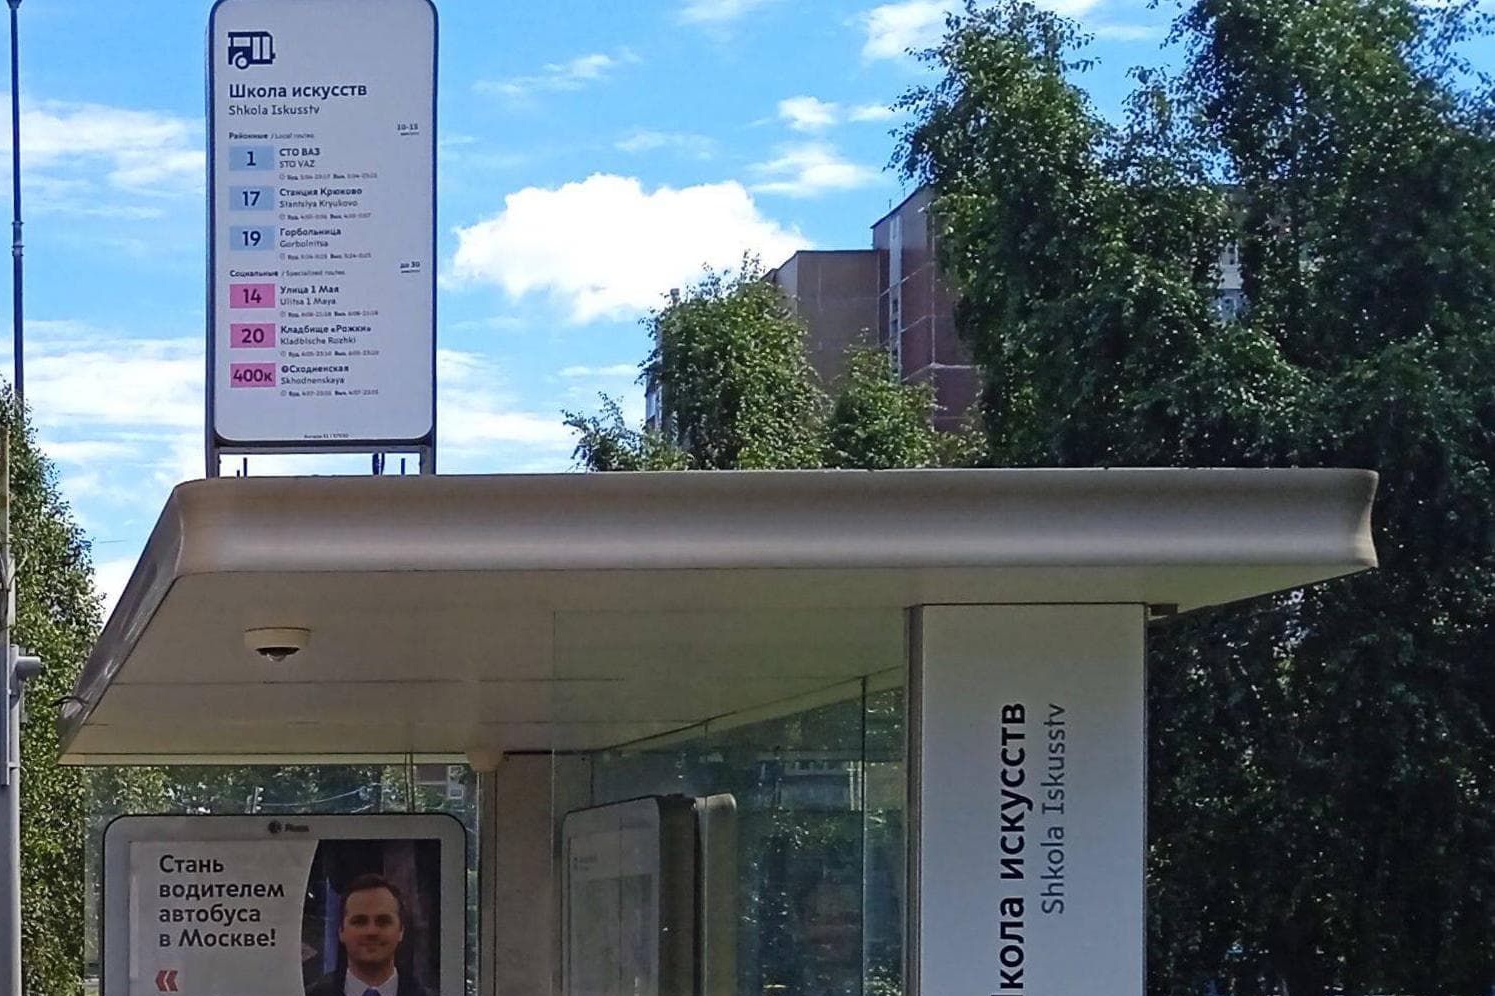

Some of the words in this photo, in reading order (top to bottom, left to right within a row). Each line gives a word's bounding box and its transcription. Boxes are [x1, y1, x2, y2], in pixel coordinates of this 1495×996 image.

[229, 84, 287, 98] Школа
[292, 85, 367, 100] искусств
[228, 105, 268, 115] Shkola
[271, 104, 320, 115] Iskusstv
[246, 151, 257, 166] 1
[279, 148, 299, 156] СТО
[301, 148, 320, 156] ВАЗ
[279, 160, 296, 168] STO
[298, 160, 315, 168] VAZ
[242, 191, 260, 206] 17
[279, 188, 318, 197] Станция
[321, 188, 362, 197] Крюково
[319, 200, 358, 208] Kryukovo
[242, 230, 261, 246] 19
[280, 228, 341, 237] Горбольница
[243, 288, 262, 304] 14
[280, 286, 308, 294] Улица
[318, 285, 339, 293] Мая
[313, 298, 336, 306] Maya
[241, 328, 264, 343] 20
[281, 325, 328, 334] Кладбище
[331, 324, 371, 333] «Рожки»
[233, 368, 273, 382] 400к
[290, 365, 349, 374] Сходненская
[281, 377, 345, 386] Skhodnenskaya
[1041, 703, 1066, 815] Iskusstv
[1000, 702, 1034, 880] искусств
[159, 855, 224, 873] Стань
[1040, 826, 1065, 915] Shkola
[159, 881, 284, 900] водителем
[159, 903, 261, 926] автобуса
[159, 934, 171, 947] в
[178, 928, 276, 948] Москве!
